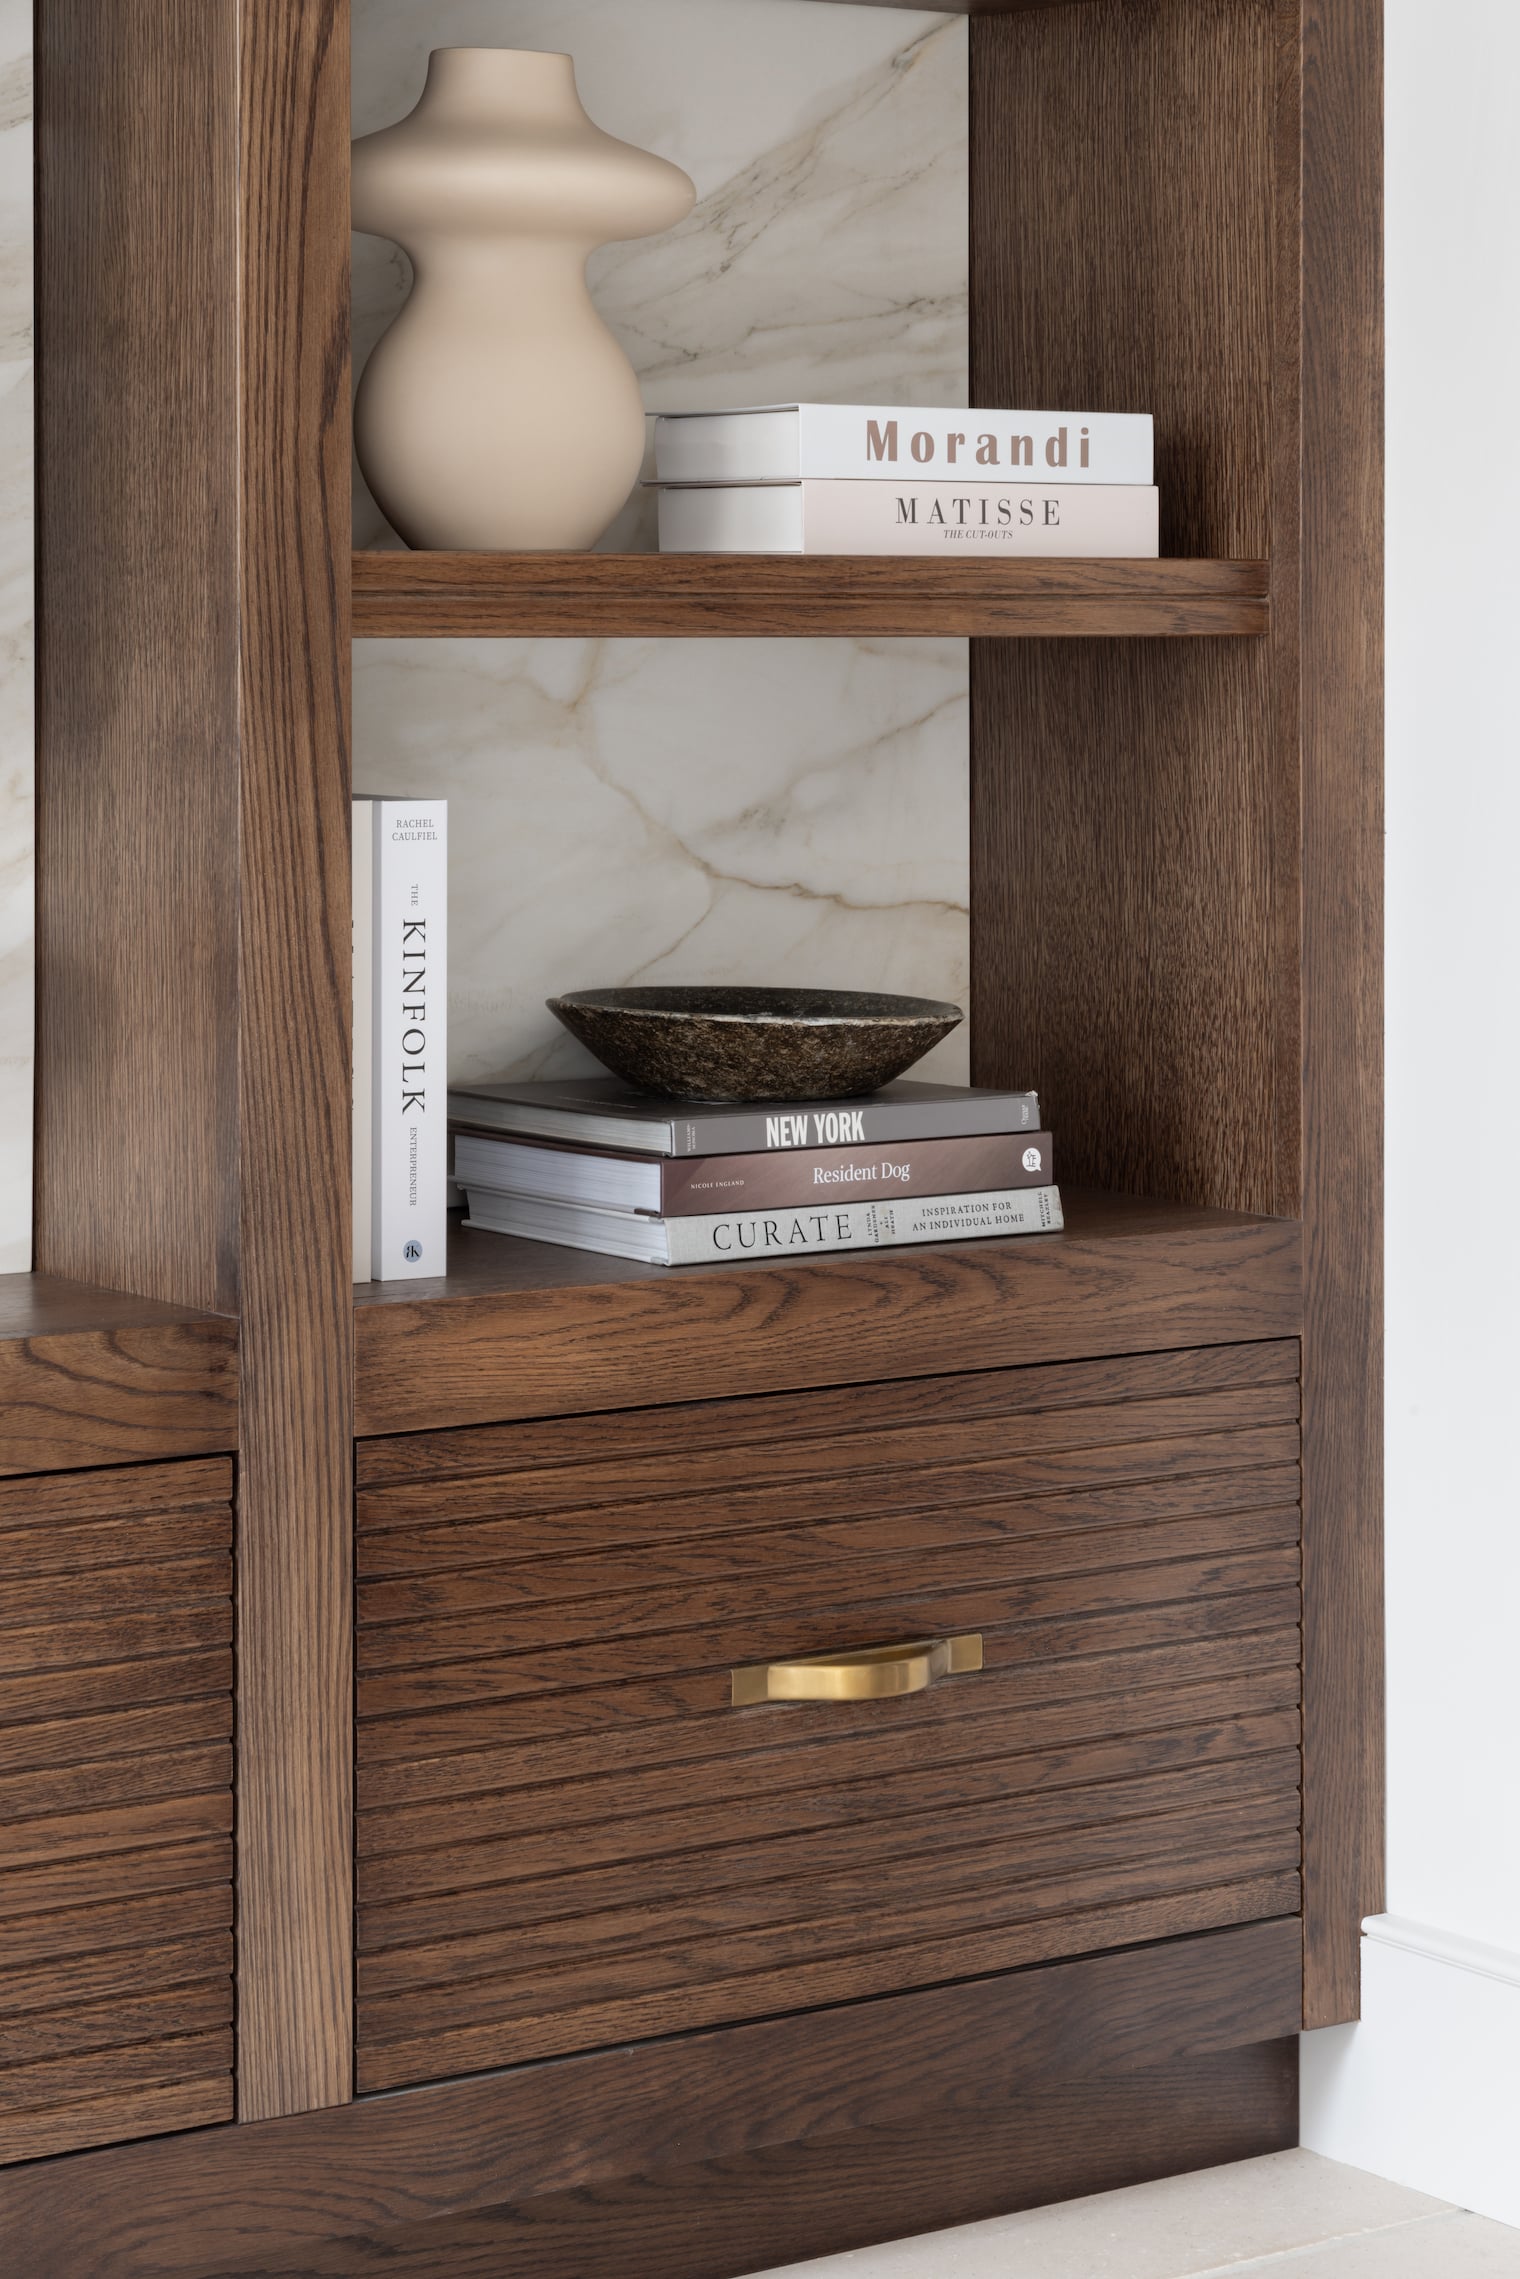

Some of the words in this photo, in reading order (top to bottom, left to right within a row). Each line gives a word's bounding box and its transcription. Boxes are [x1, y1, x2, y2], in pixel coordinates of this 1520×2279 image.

[867, 420, 1089, 468] Morandi
[895, 498, 1060, 525] MATISSE
[944, 530, 964, 539] THE
[965, 530, 1013, 539] CUT-OUTS
[396, 819, 434, 828] RACHEL
[392, 832, 438, 841] CAULFIEL
[402, 918, 426, 1115] KINFOLK
[766, 1115, 808, 1147] NEW
[814, 1111, 865, 1144] YORK
[813, 1164, 877, 1184] Resident
[881, 1162, 910, 1182] Dog
[715, 1180, 745, 1188] ENGLAND
[922, 1203, 989, 1217] INSPIRATION
[992, 1201, 1012, 1212] FOR
[713, 1214, 852, 1250] CURATE
[912, 1220, 926, 1231] AN
[930, 1217, 992, 1230] INDIVIDUAL
[995, 1213, 1025, 1224] HOME
